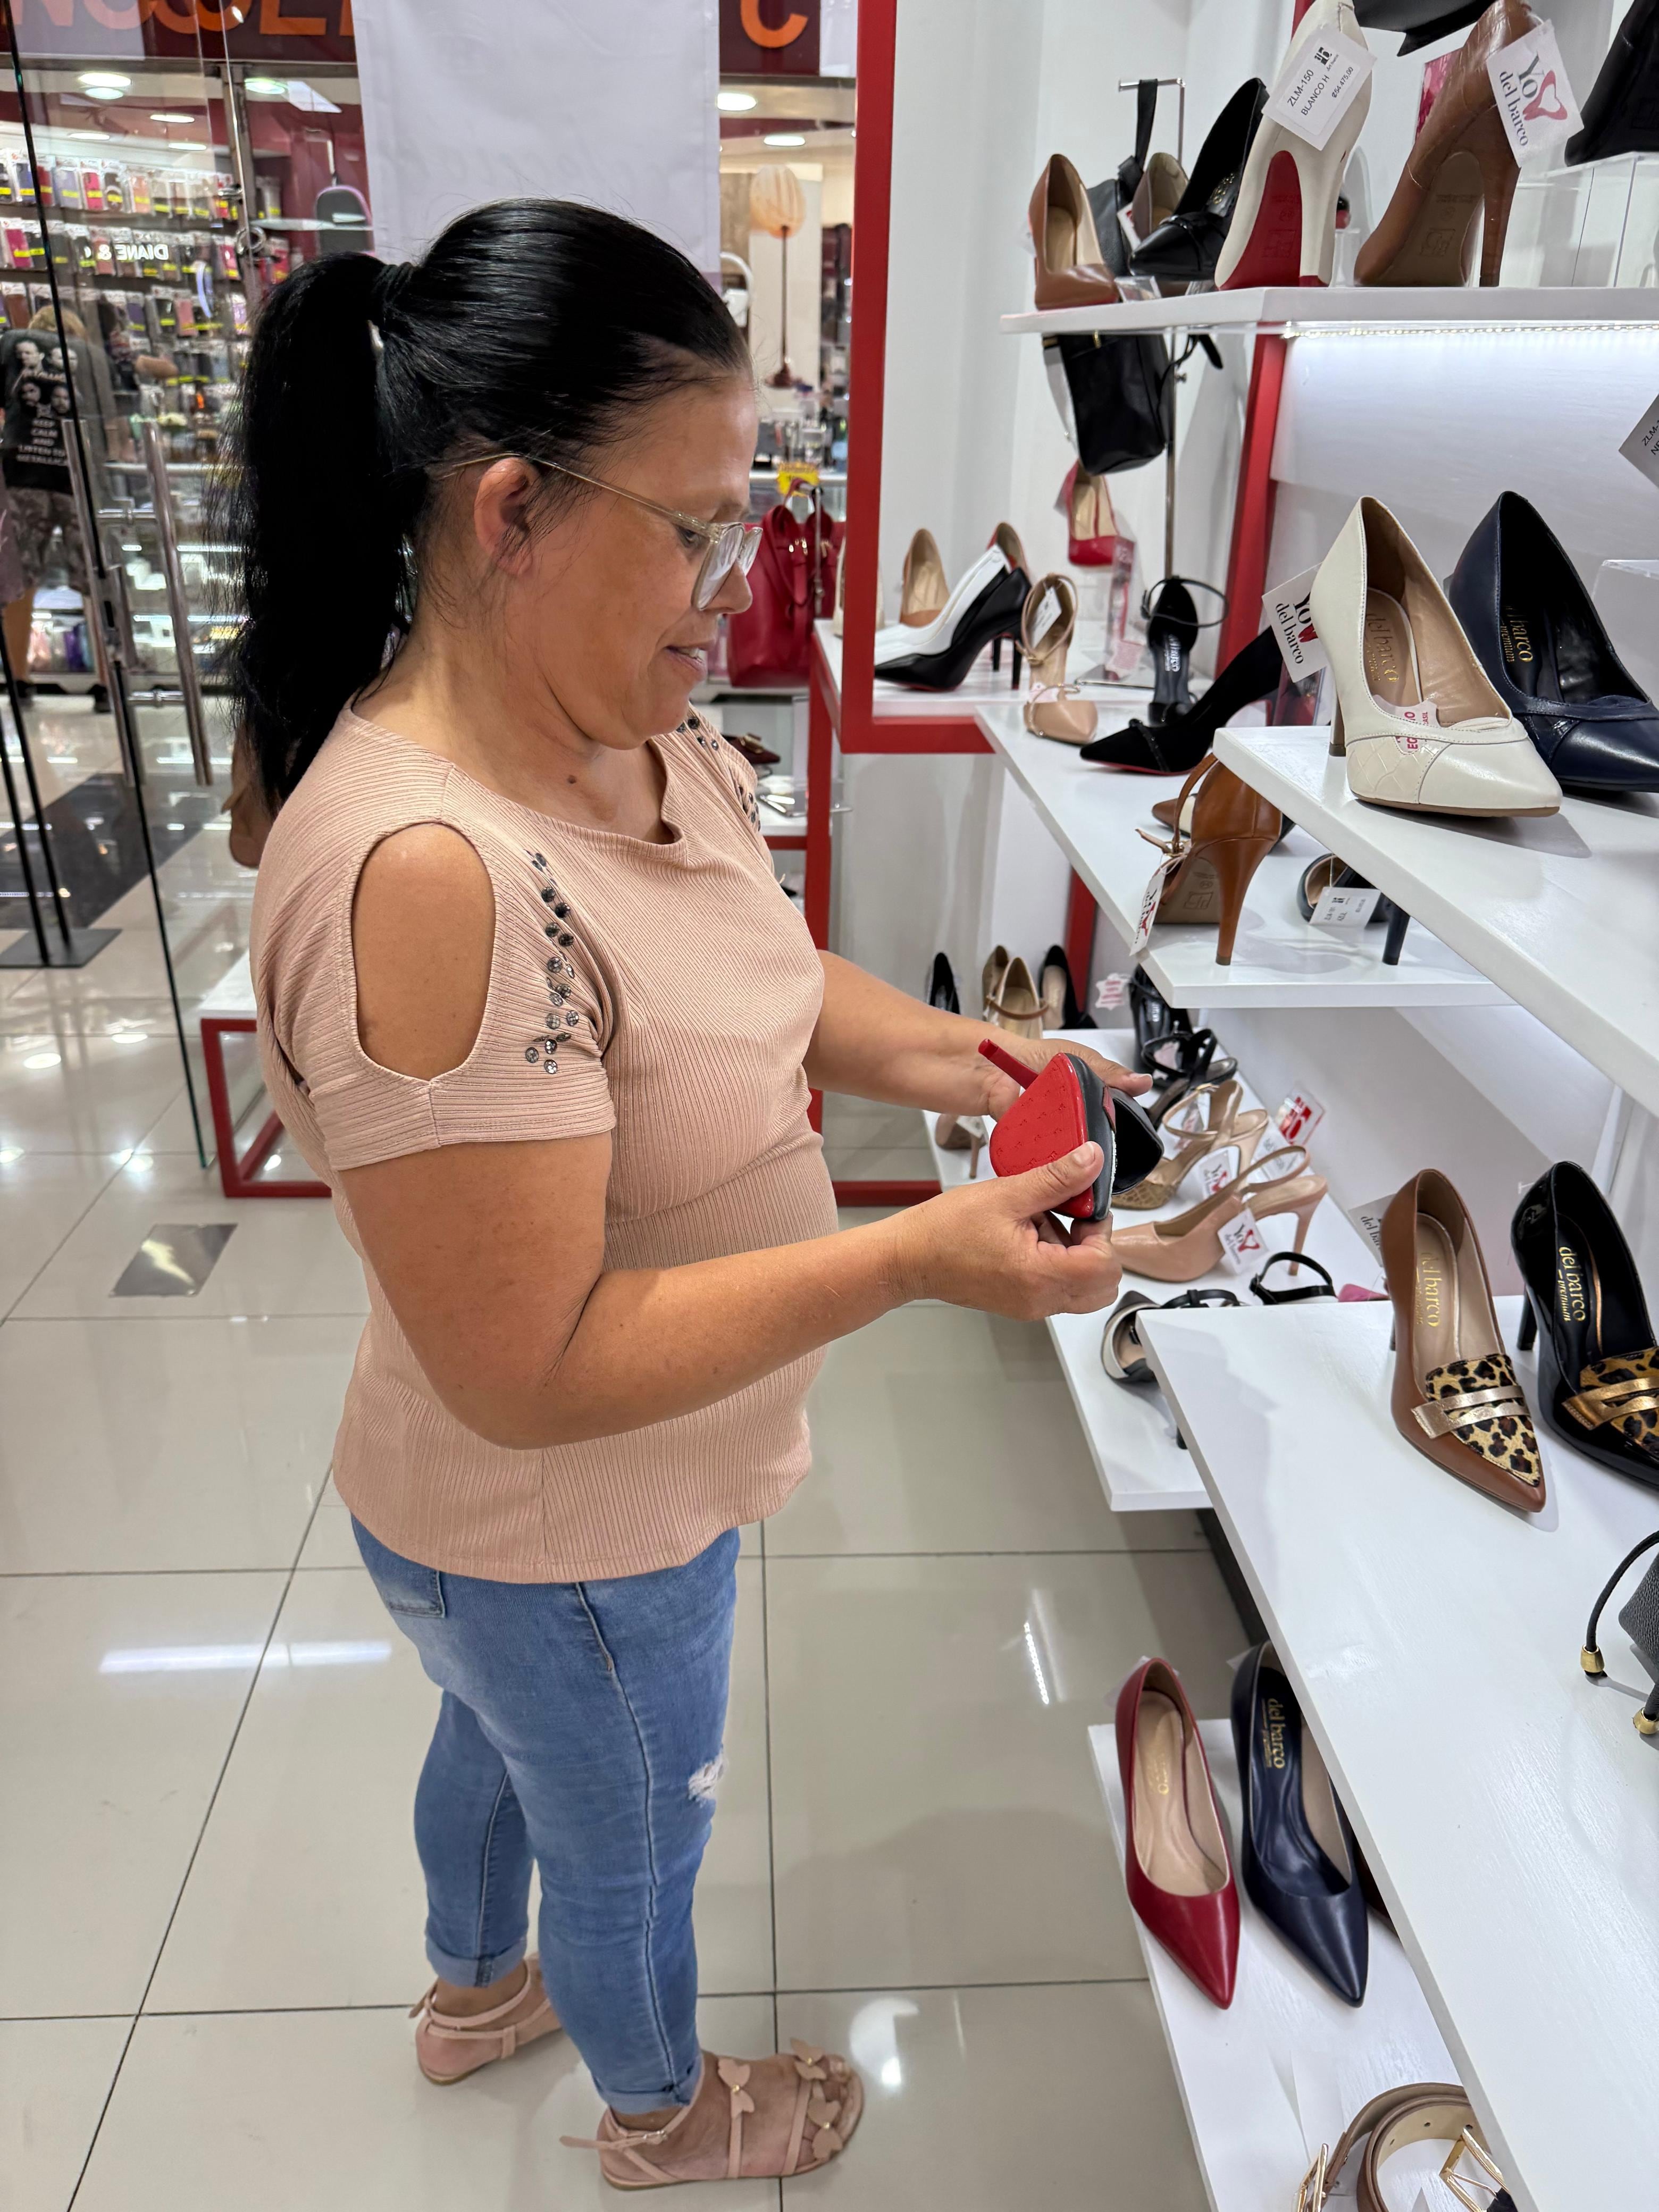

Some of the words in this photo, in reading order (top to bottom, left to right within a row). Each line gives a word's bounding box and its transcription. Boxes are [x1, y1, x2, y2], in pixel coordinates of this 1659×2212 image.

[1287, 69, 1314, 107] ZLM-150
[1301, 82, 1325, 115] BLANCO
[1322, 74, 1330, 83] H
[1499, 71, 1517, 98] del
[1517, 51, 1545, 99] Yo
[1507, 96, 1529, 147] barco
[1276, 603, 1294, 625] del
[1284, 624, 1304, 664] barco
[1510, 620, 1534, 663] barco
[1361, 1216, 1378, 1230] del
[1559, 1246, 1582, 1269] del
[1424, 1277, 1443, 1327] barco
[1566, 1272, 1586, 1322] barco
